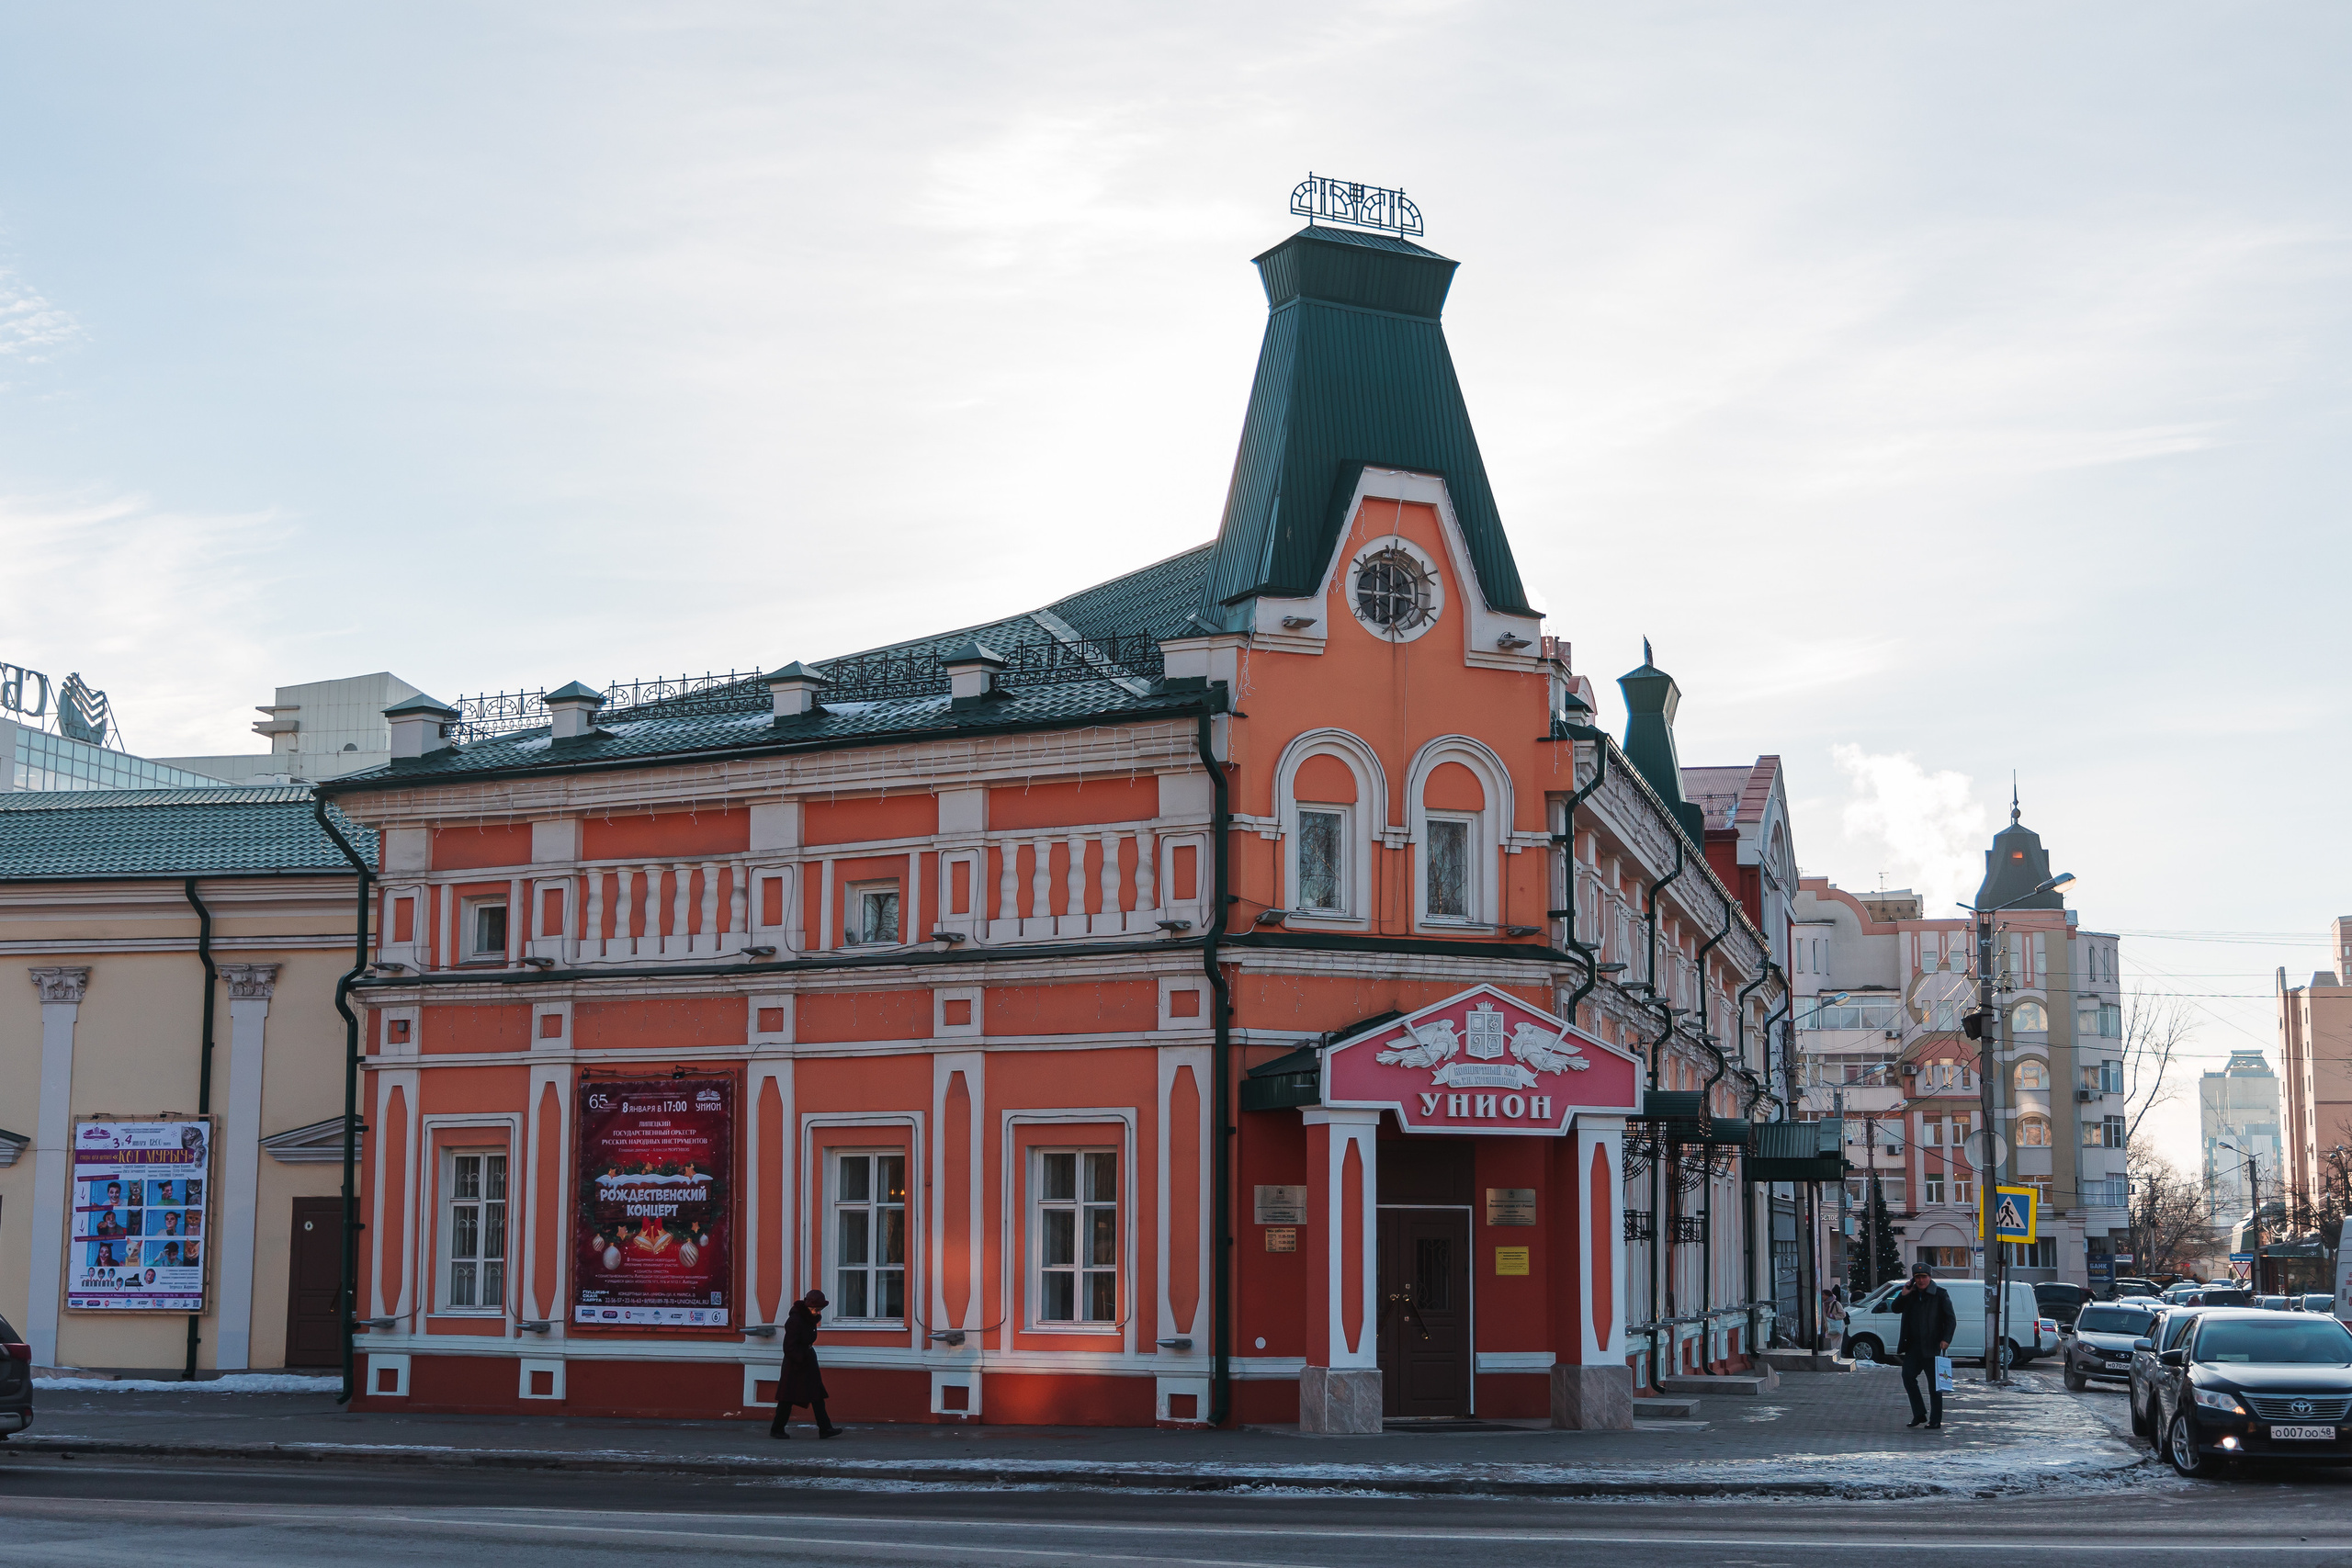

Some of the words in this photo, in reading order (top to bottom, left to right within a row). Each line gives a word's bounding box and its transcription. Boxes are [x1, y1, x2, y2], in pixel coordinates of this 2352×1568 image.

[1453, 1066, 1501, 1076] КОНЦЕРТНЫЙ
[1504, 1067, 1517, 1077] ЗАЛ
[589, 1094, 608, 1110] 65
[622, 1101, 628, 1113] 8
[663, 1100, 687, 1112] 17:00
[695, 1102, 721, 1111] УНИОН
[1419, 1092, 1553, 1119] УНИОН
[113, 1138, 120, 1148] 3
[125, 1134, 132, 1145] 4
[600, 1186, 707, 1202] РОЖДЕСТВЕНСКИЙ
[627, 1204, 679, 1218] КОНЦЕРТ
[2321, 1427, 2332, 1436] 48
